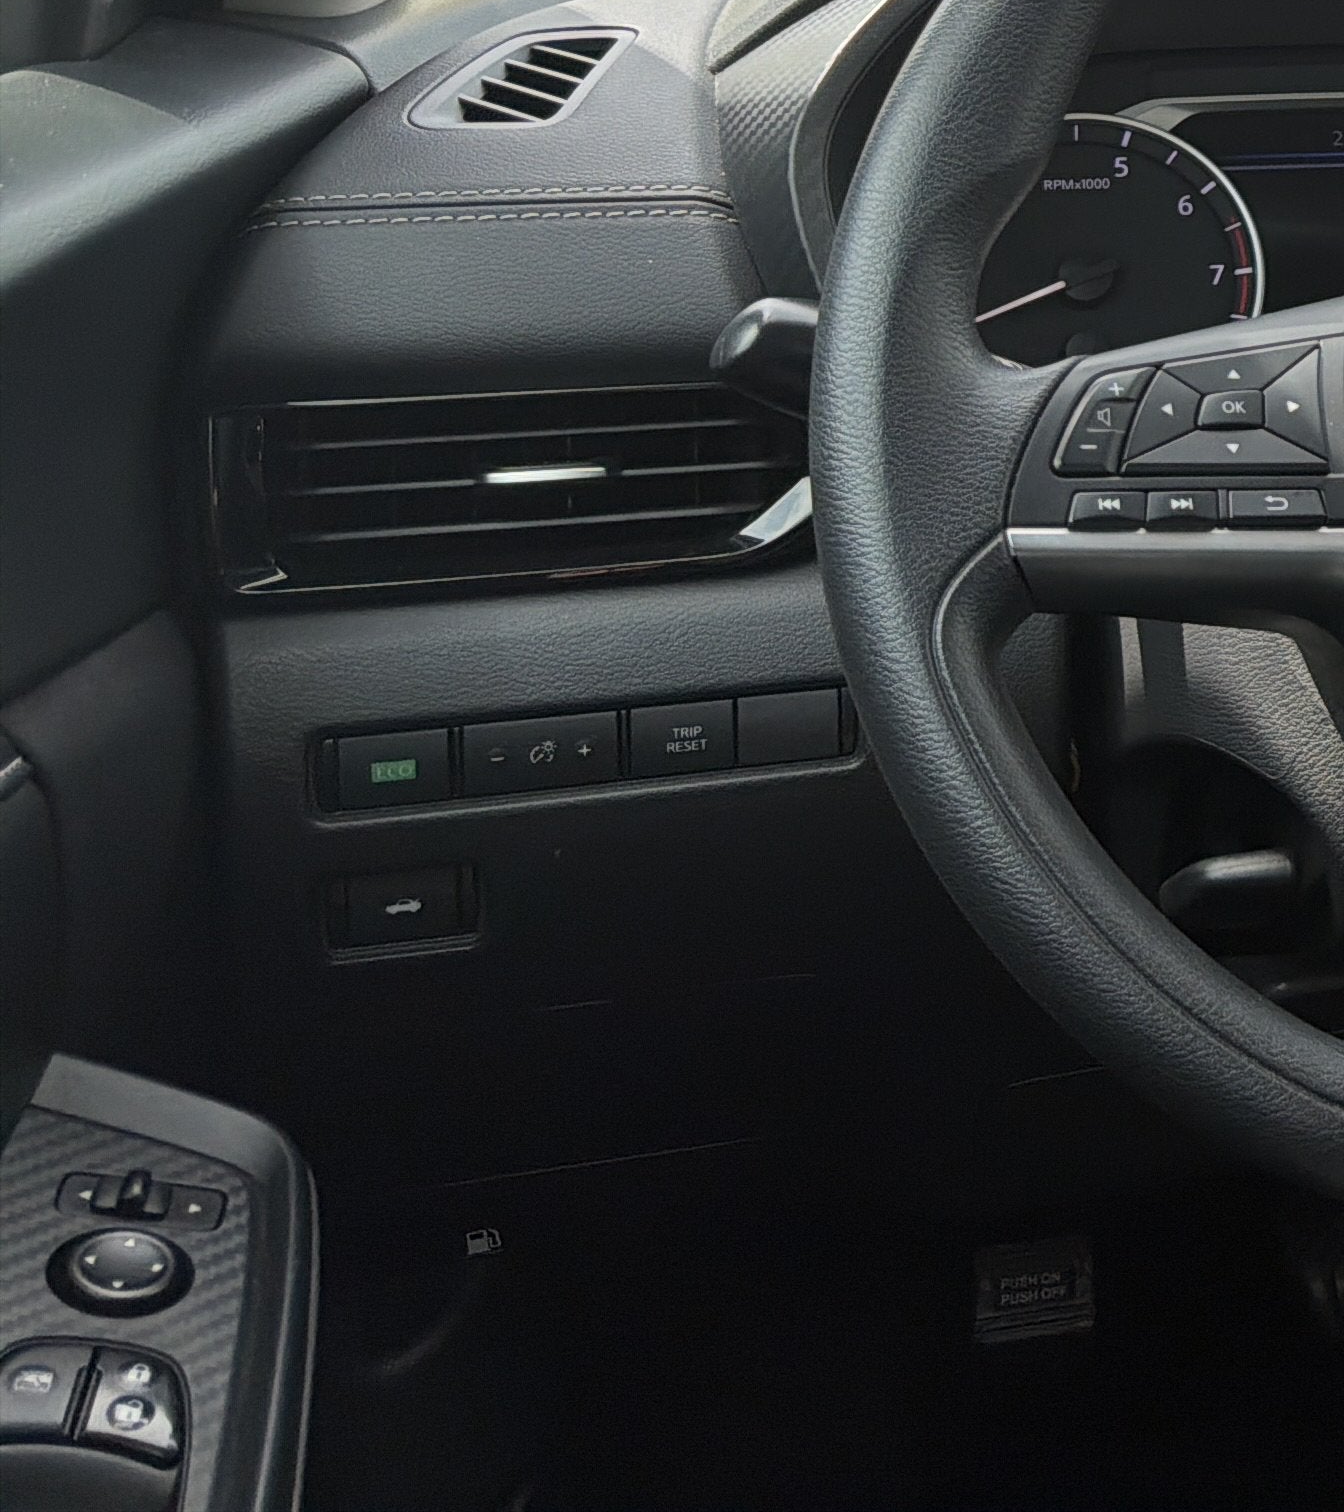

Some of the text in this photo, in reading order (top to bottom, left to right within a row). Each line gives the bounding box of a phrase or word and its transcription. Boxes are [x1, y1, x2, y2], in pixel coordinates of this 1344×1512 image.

[1113, 156, 1129, 178] 5
[1177, 194, 1194, 216] 6
[1208, 264, 1225, 286] 7
[1221, 399, 1247, 415] OK
[672, 725, 703, 739] TRIP
[666, 738, 708, 753] RESET
